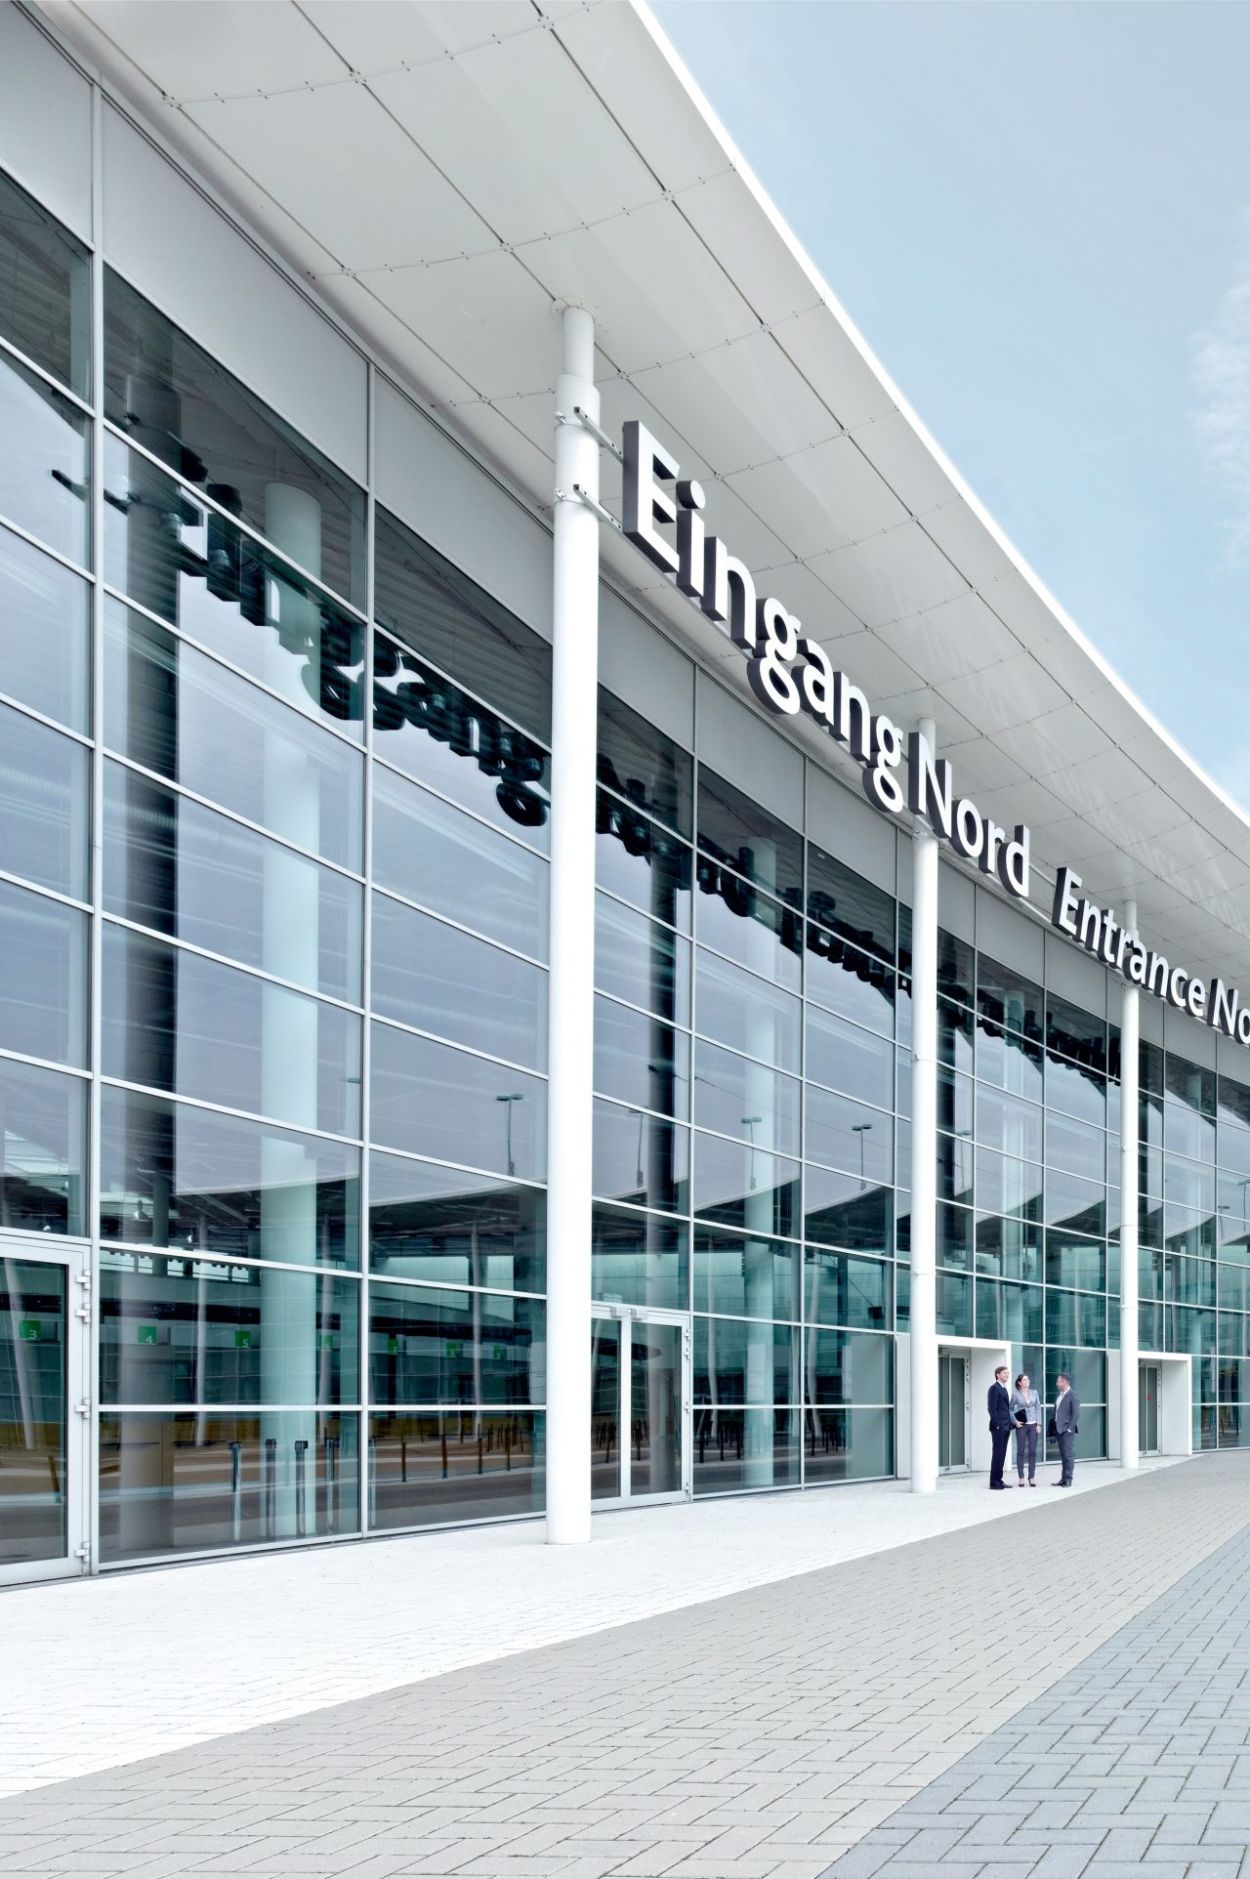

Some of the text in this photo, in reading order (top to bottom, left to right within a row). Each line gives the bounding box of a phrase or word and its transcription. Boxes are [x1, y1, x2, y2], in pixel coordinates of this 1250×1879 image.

[623, 421, 904, 813] Eingang
[908, 731, 1030, 897] Nord
[1052, 866, 1206, 1018] Entrance
[28, 1329, 38, 1339] 3
[144, 1335, 153, 1344] 4
[242, 1340, 249, 1349] 5
